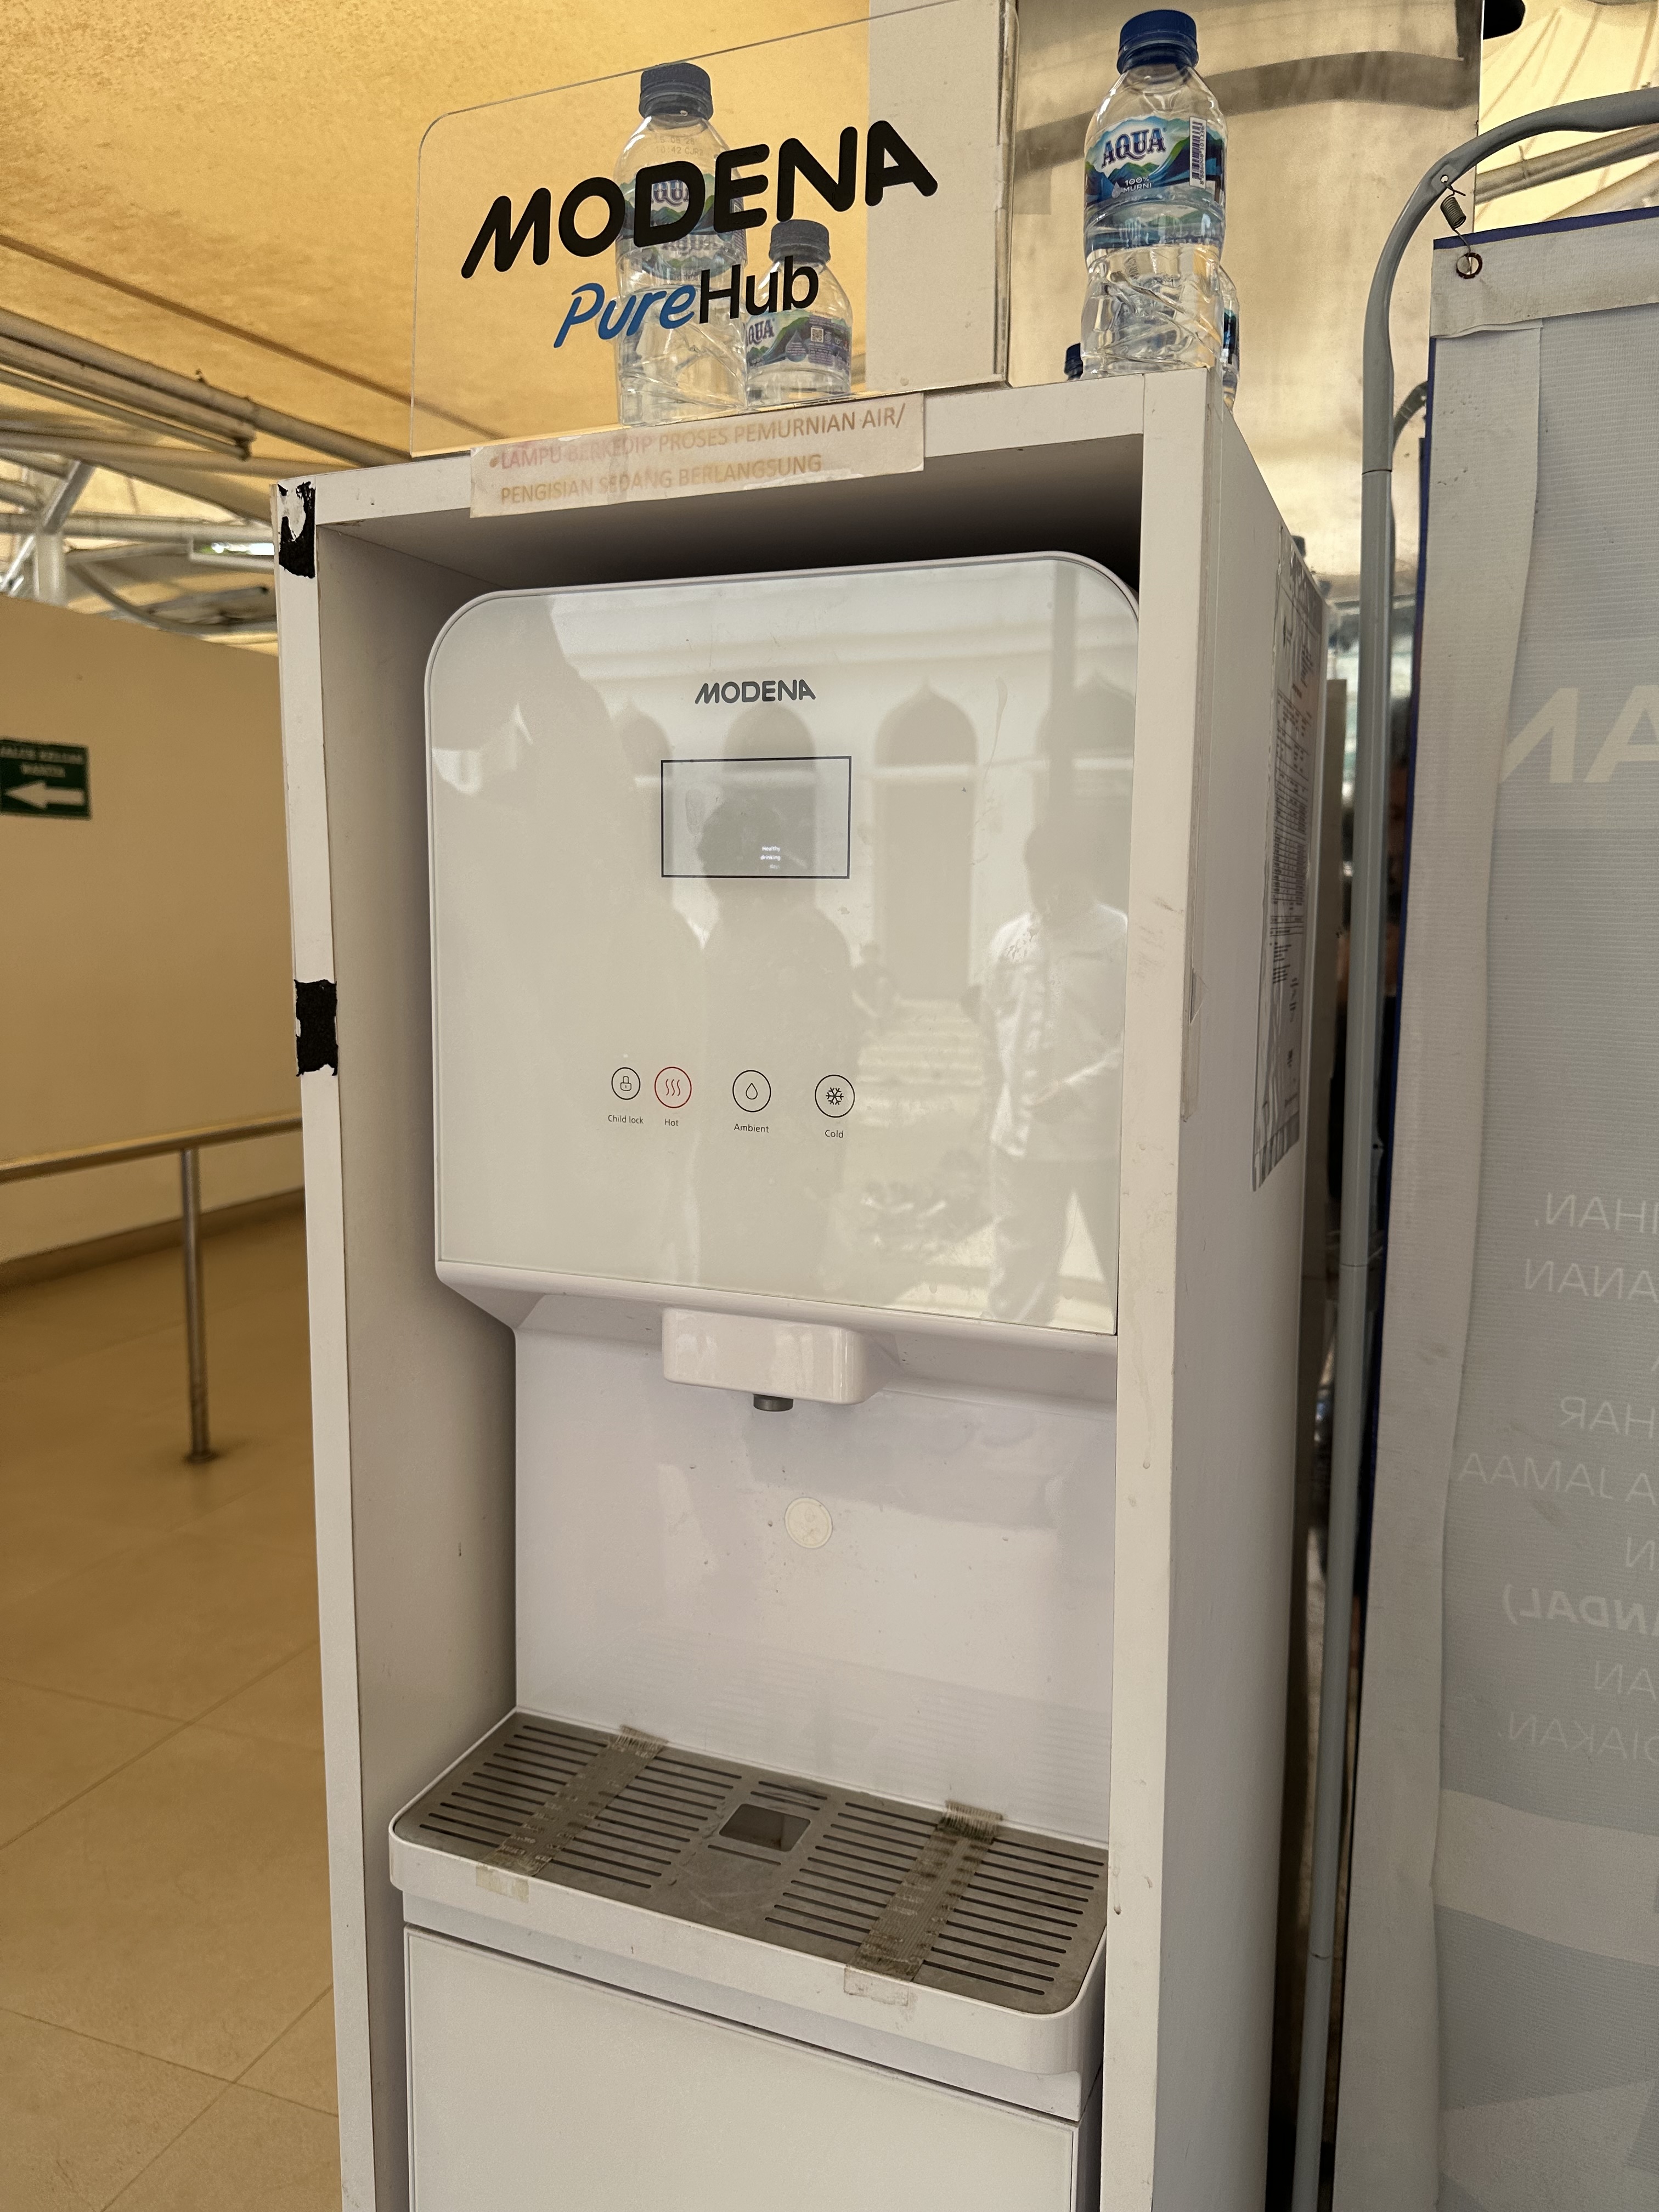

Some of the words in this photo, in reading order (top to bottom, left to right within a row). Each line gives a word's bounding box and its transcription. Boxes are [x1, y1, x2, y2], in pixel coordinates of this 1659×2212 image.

[1101, 128, 1167, 169] AQUA
[1123, 182, 1152, 194] MURNI
[1125, 176, 1150, 186] 100%
[461, 120, 938, 279] MODENA
[553, 256, 819, 348] PureHub
[501, 445, 562, 470] LAMPU
[659, 427, 728, 452] PROSES
[734, 411, 855, 443] PEMURNIAN
[862, 403, 906, 429] AIR/
[501, 478, 593, 505] PENGISIAN
[599, 469, 672, 494] SEDANG
[679, 453, 822, 486] BERLANGSUNG
[695, 679, 816, 704] MODENA
[607, 1114, 627, 1123] Child
[629, 1116, 644, 1124] lock
[733, 1123, 769, 1133] Ambient
[825, 1129, 844, 1138] Cold
